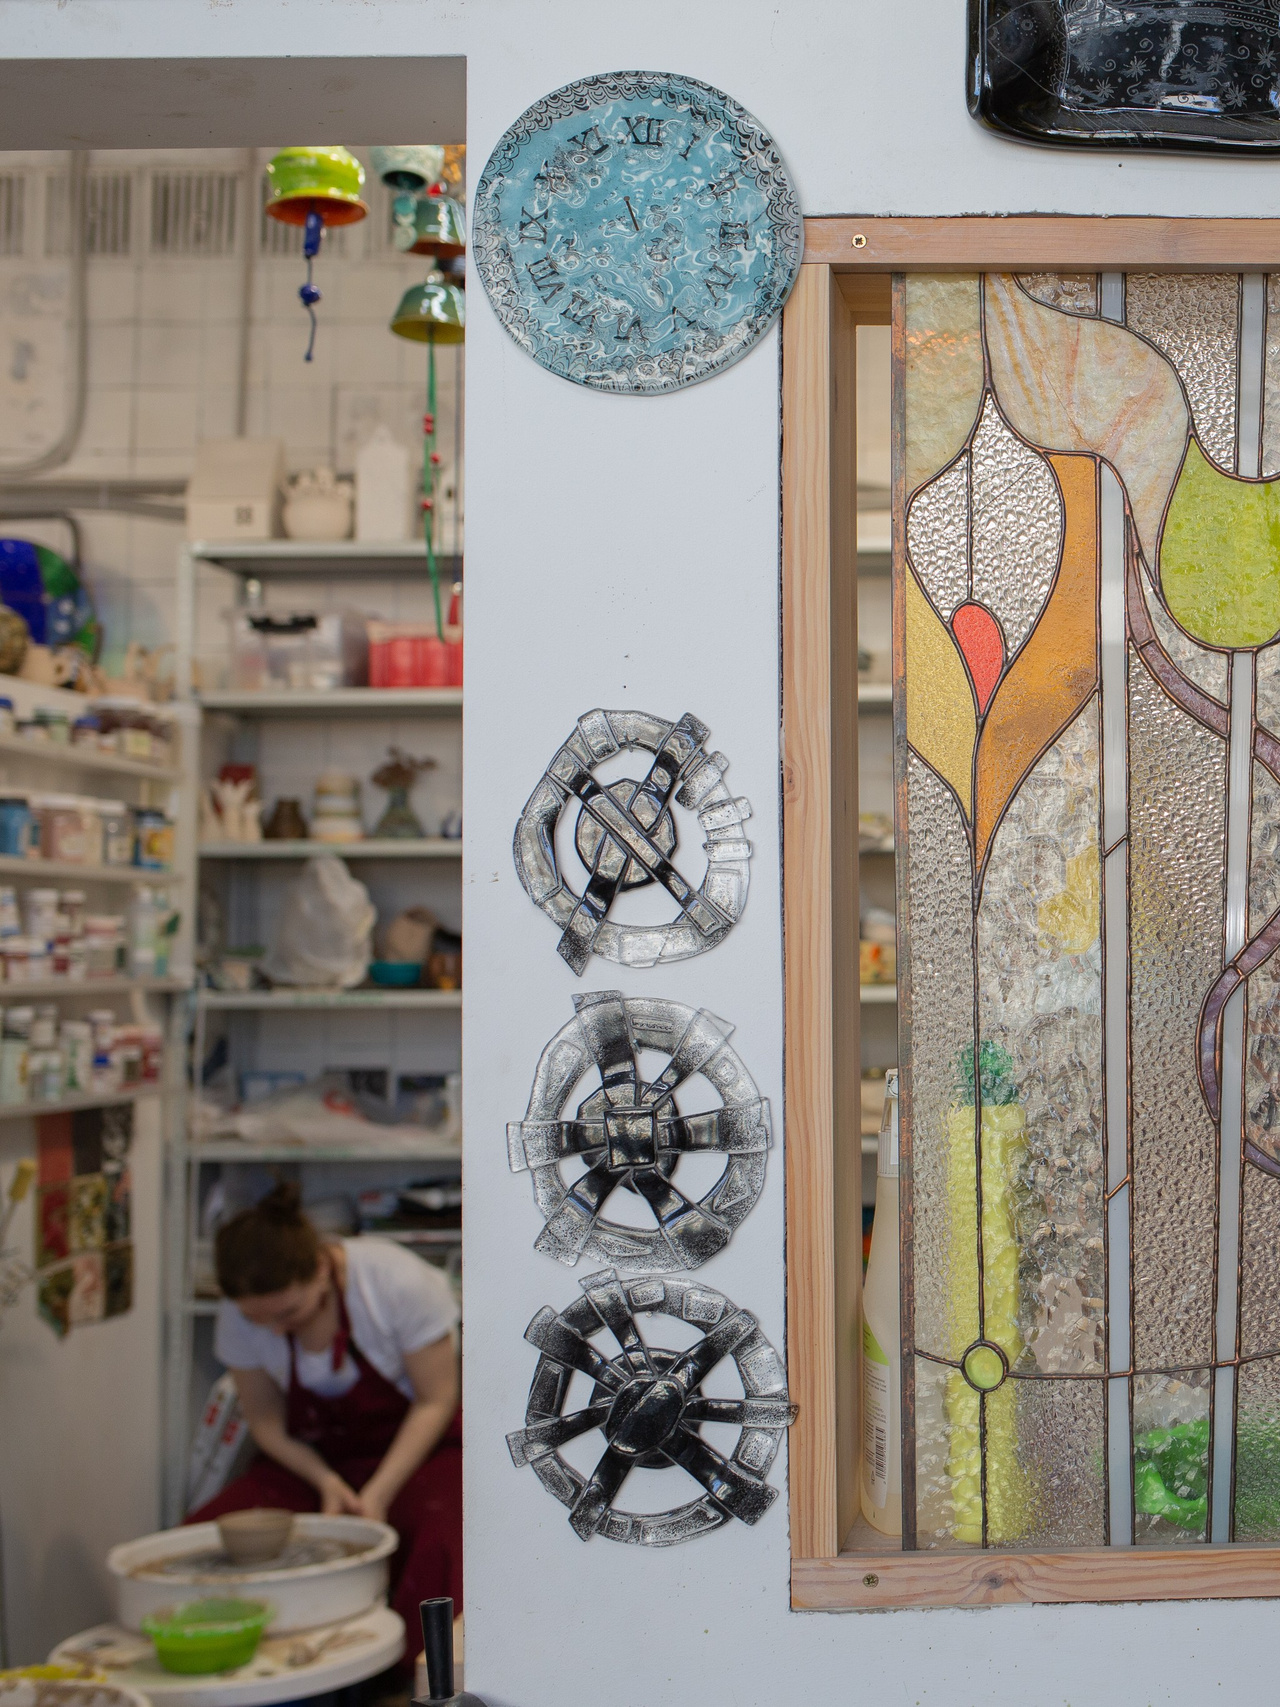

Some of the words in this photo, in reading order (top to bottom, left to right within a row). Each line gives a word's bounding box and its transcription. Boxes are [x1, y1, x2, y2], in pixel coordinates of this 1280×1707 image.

[617, 115, 664, 147] XII
[519, 206, 549, 245] IX
[525, 252, 566, 305] VIII
